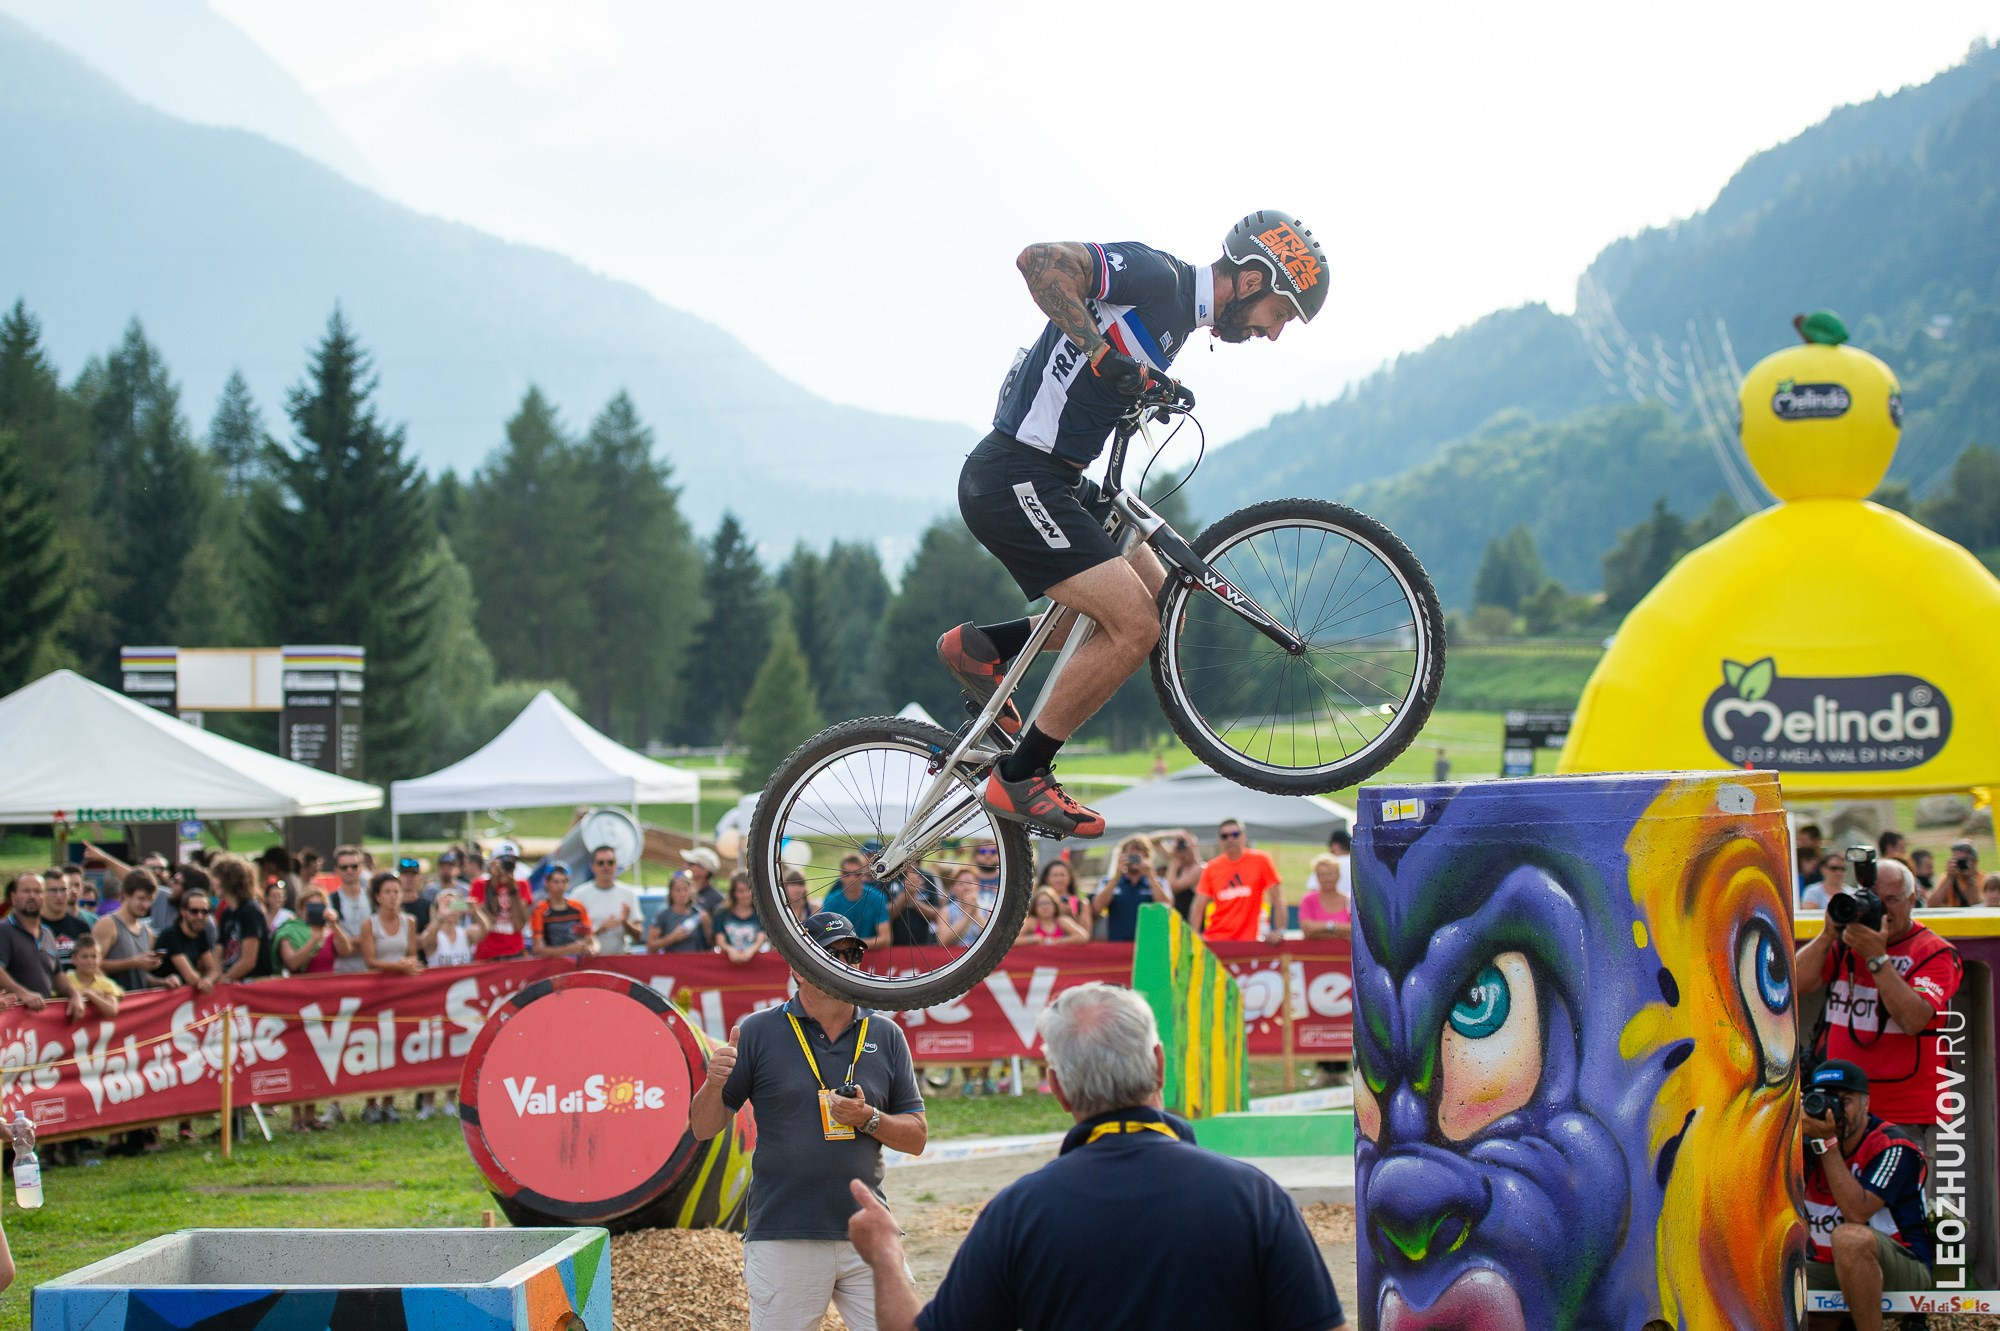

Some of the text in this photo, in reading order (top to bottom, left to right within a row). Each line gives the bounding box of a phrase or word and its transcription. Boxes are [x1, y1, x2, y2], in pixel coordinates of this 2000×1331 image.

[1258, 229, 1313, 291] BIKES
[1273, 221, 1321, 287] TRIAL
[1024, 495, 1061, 539] CLEAN
[1777, 747, 1826, 764] MELA
[1824, 747, 1857, 764] VAL
[1858, 746, 1877, 763] DI
[1878, 744, 1925, 763] NON
[77, 806, 197, 823] Heineken
[72, 1021, 146, 1116] Val
[142, 1040, 179, 1093] di
[171, 1001, 288, 1086] Sole
[300, 997, 397, 1086] Val
[402, 1014, 445, 1064] di
[502, 1073, 666, 1119] Val di Sole
[1909, 1295, 1936, 1313] Val
[1937, 1301, 1949, 1312] di
[1950, 1295, 1990, 1313] Sole
